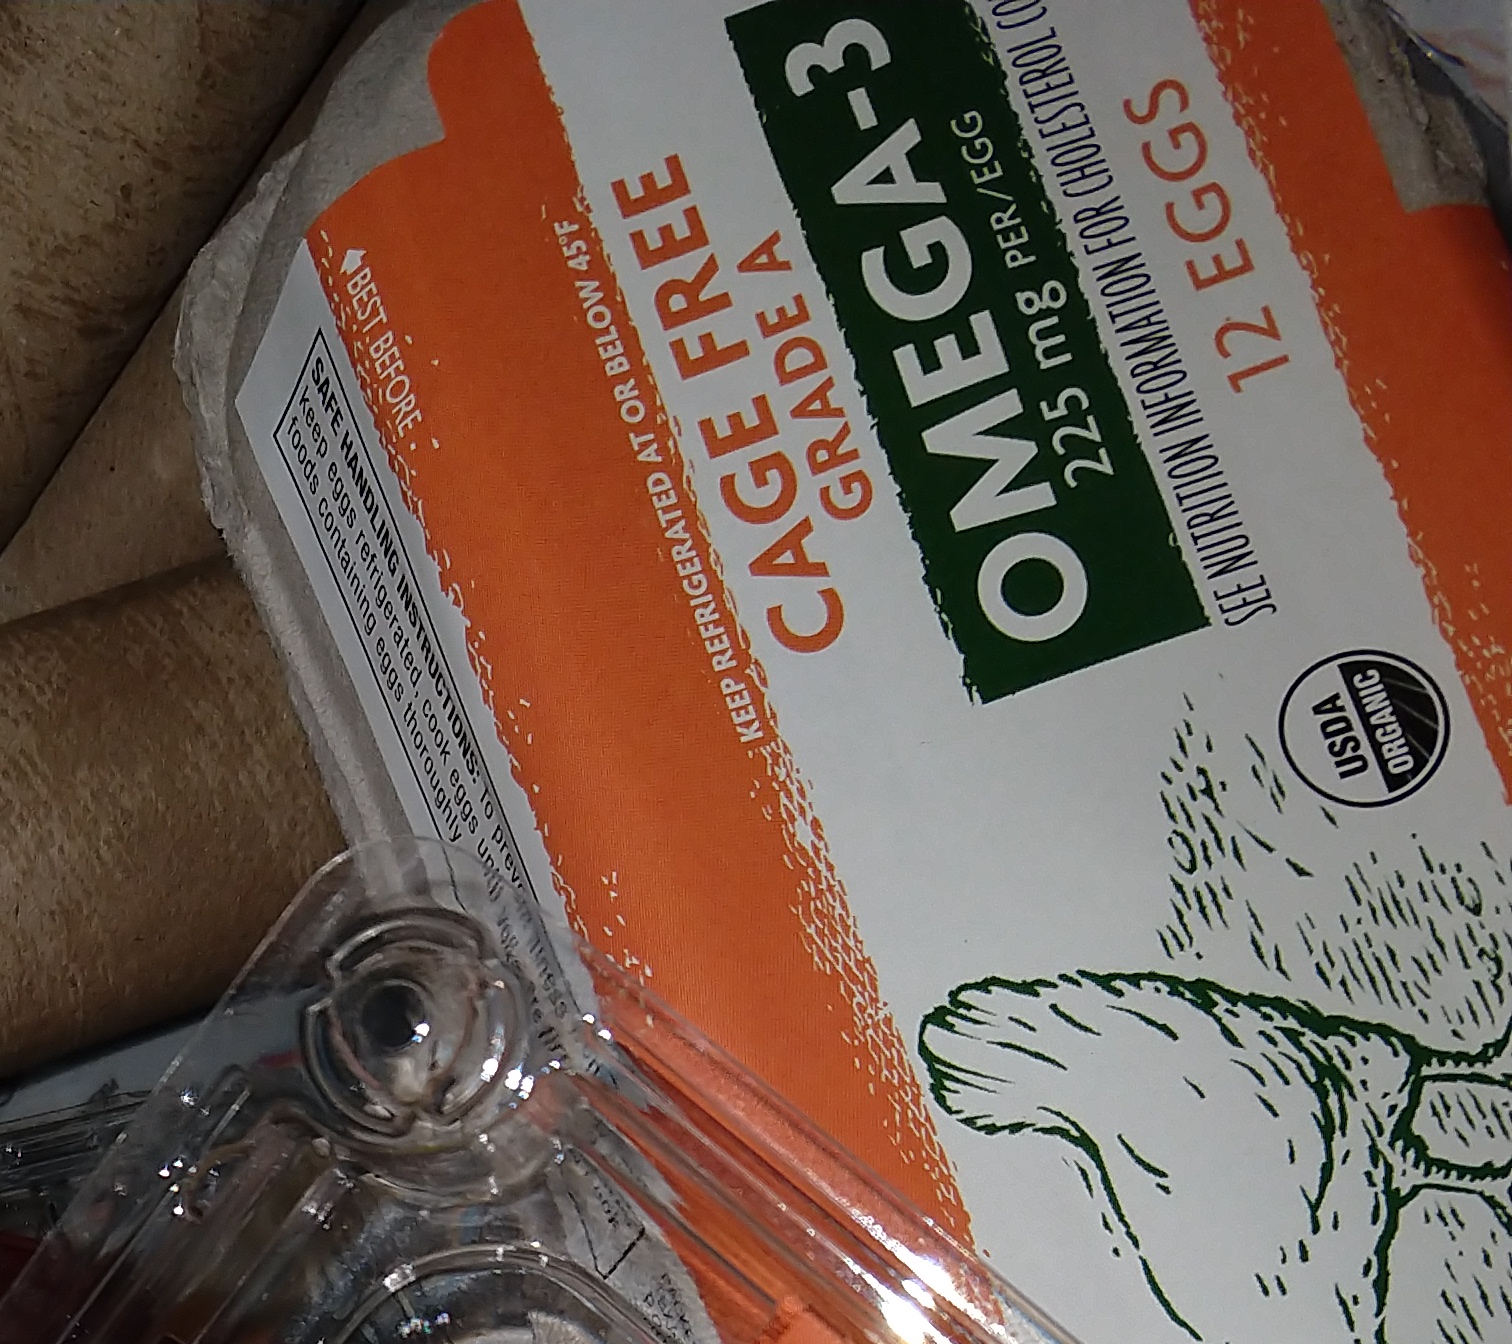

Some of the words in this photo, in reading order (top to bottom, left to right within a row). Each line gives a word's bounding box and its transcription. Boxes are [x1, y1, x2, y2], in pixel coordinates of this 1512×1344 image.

[1006, 26, 1114, 198] CHOLESTEROL
[1123, 78, 1255, 291] EGGS
[554, 220, 592, 271] 45°F
[736, 229, 794, 275] A
[950, 109, 1037, 270] PER/EGG
[1073, 195, 1137, 255] FOR
[575, 280, 631, 377] BELOW
[611, 153, 751, 381] FREE
[784, 18, 1088, 643] OMEGA-3
[1018, 277, 1074, 369] mg
[347, 270, 387, 333] BEST
[369, 331, 423, 438] BEFORE
[613, 377, 645, 424] OR
[755, 292, 874, 521] GRADE
[1092, 252, 1204, 437] INFORMATION
[1214, 305, 1290, 394] 12
[629, 432, 663, 463] AT
[1043, 387, 1115, 490] 225
[1159, 434, 1258, 580] NUTRITION
[311, 357, 344, 436] SAFE
[340, 431, 400, 577] HANDLING
[396, 574, 481, 785] INSTRUCTIONS:
[478, 786, 495, 820] To
[646, 471, 738, 673] REFRIGERATED
[699, 394, 845, 655] CAGE
[287, 415, 321, 496] foods
[317, 495, 377, 637] containing
[375, 639, 405, 702] eggs
[402, 701, 464, 844] thoroughly
[326, 461, 357, 530] eggs
[354, 528, 423, 699] refrigerated,
[422, 698, 452, 766] cook
[449, 768, 479, 835] eggs
[1214, 574, 1277, 627] SEE
[721, 677, 765, 743] KEEP
[1312, 692, 1369, 780] USDA
[1352, 668, 1415, 776] ORGANIC
